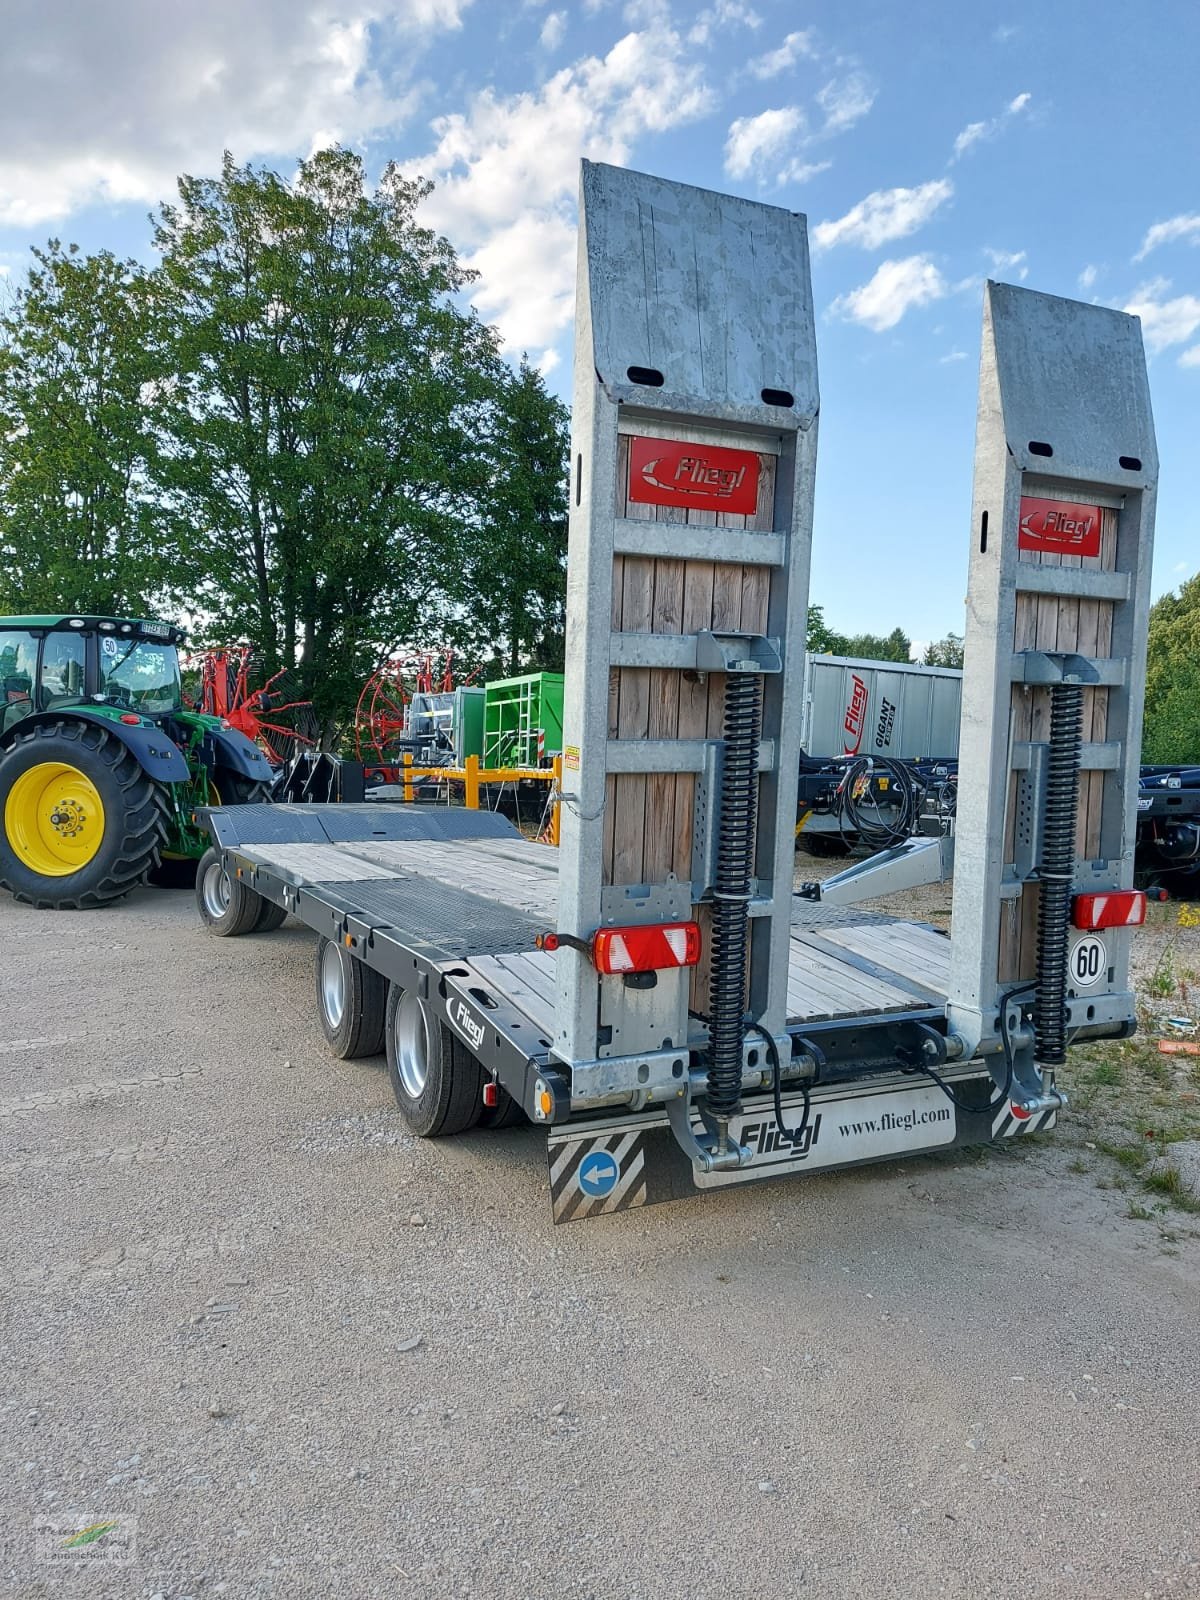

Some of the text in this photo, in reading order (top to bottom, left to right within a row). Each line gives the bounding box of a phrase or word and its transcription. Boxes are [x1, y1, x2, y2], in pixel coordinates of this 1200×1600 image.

[674, 456, 746, 493] Fliegl
[1042, 511, 1094, 540] Fliegl
[105, 640, 115, 653] 50
[844, 674, 867, 736] Fliegl
[875, 697, 890, 748] GIGANT
[1077, 945, 1099, 978] 60
[456, 1001, 486, 1047] Fliegl
[740, 1108, 951, 1156] Fliegl www.fliegl.com
